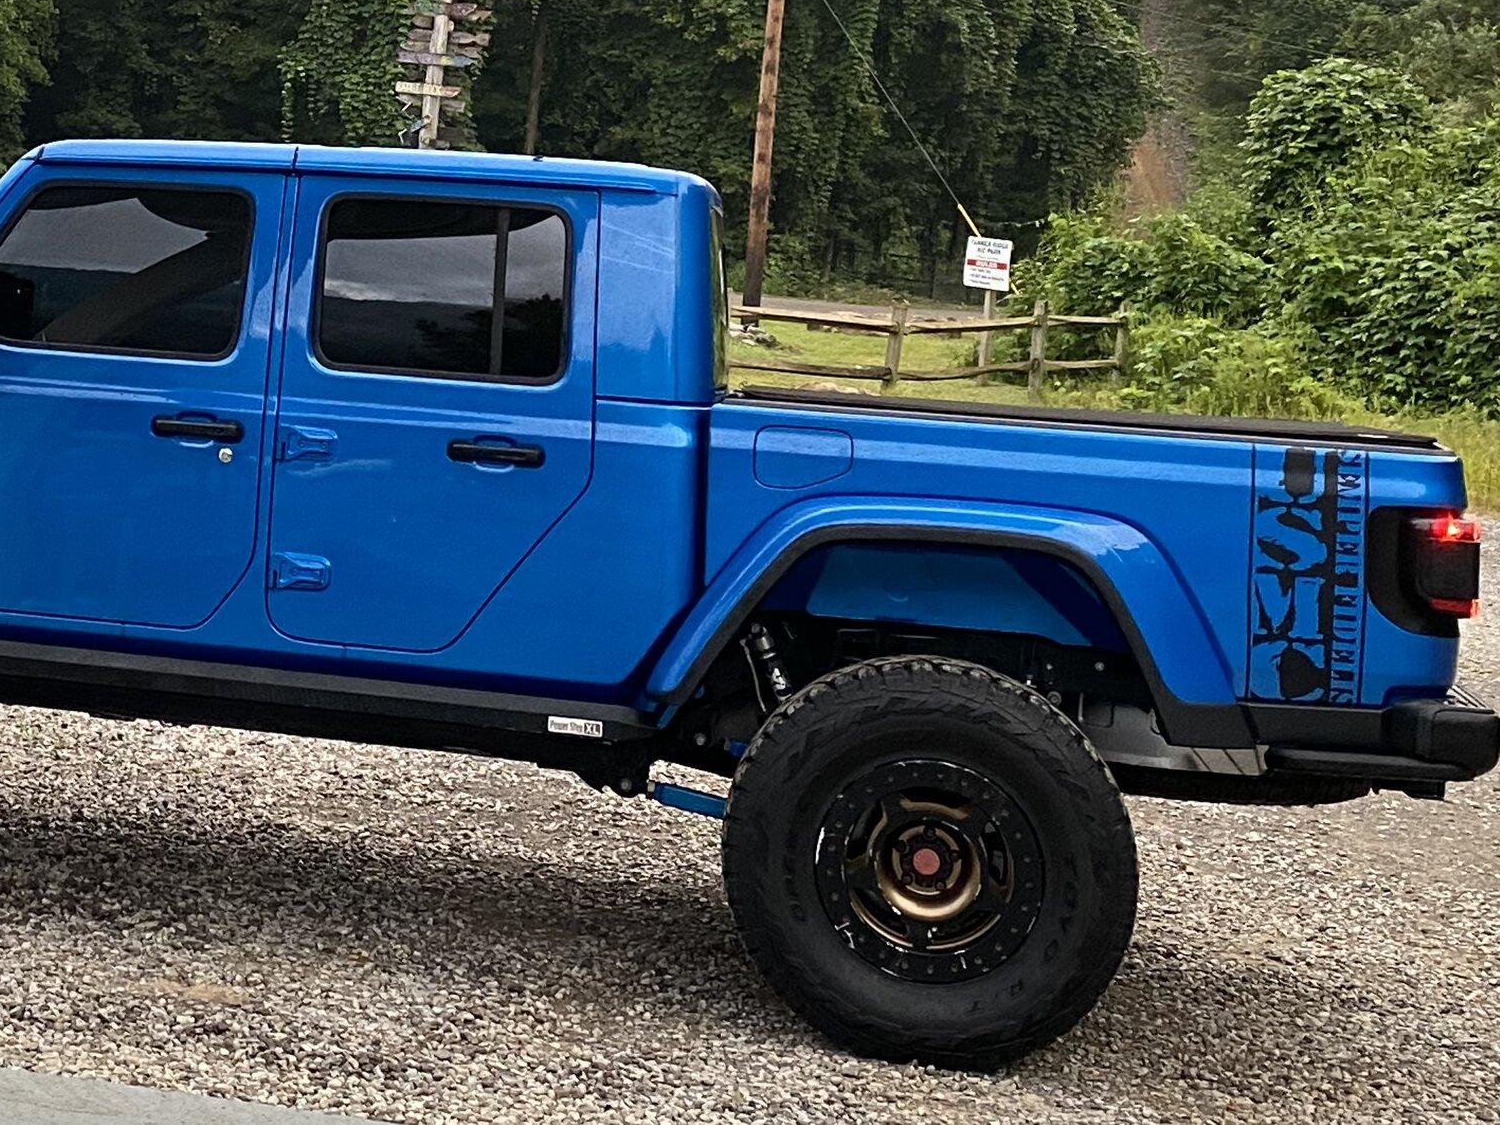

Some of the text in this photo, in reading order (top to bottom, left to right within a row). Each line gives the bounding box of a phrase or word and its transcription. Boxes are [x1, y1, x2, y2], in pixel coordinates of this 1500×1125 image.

[1329, 449, 1364, 705] SEMPER FIDELIS
[584, 722, 601, 735] XL
